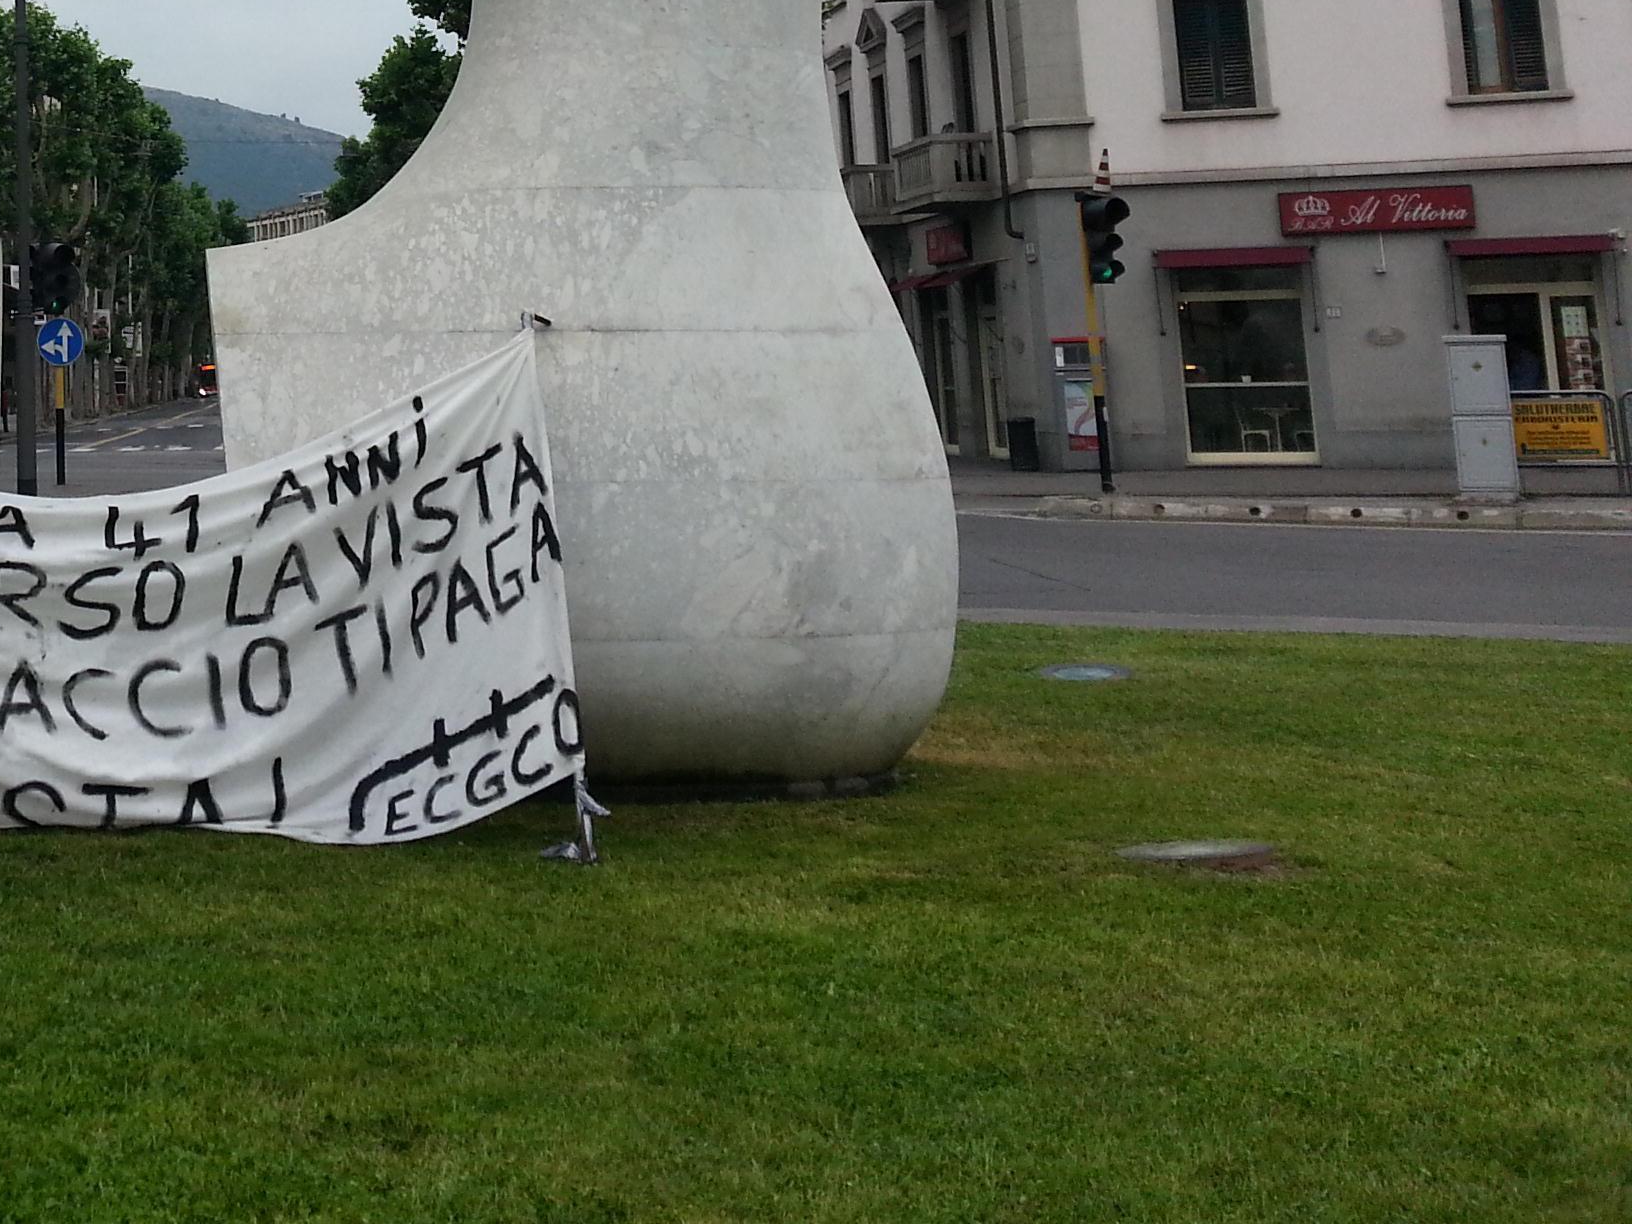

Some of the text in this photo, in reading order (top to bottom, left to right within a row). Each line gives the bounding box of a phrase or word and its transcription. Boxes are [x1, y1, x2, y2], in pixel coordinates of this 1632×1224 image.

[1389, 193, 1469, 223] Vittoria
[105, 494, 200, 557] 41
[333, 432, 548, 589] VISTA
[411, 500, 563, 659] PAGA
